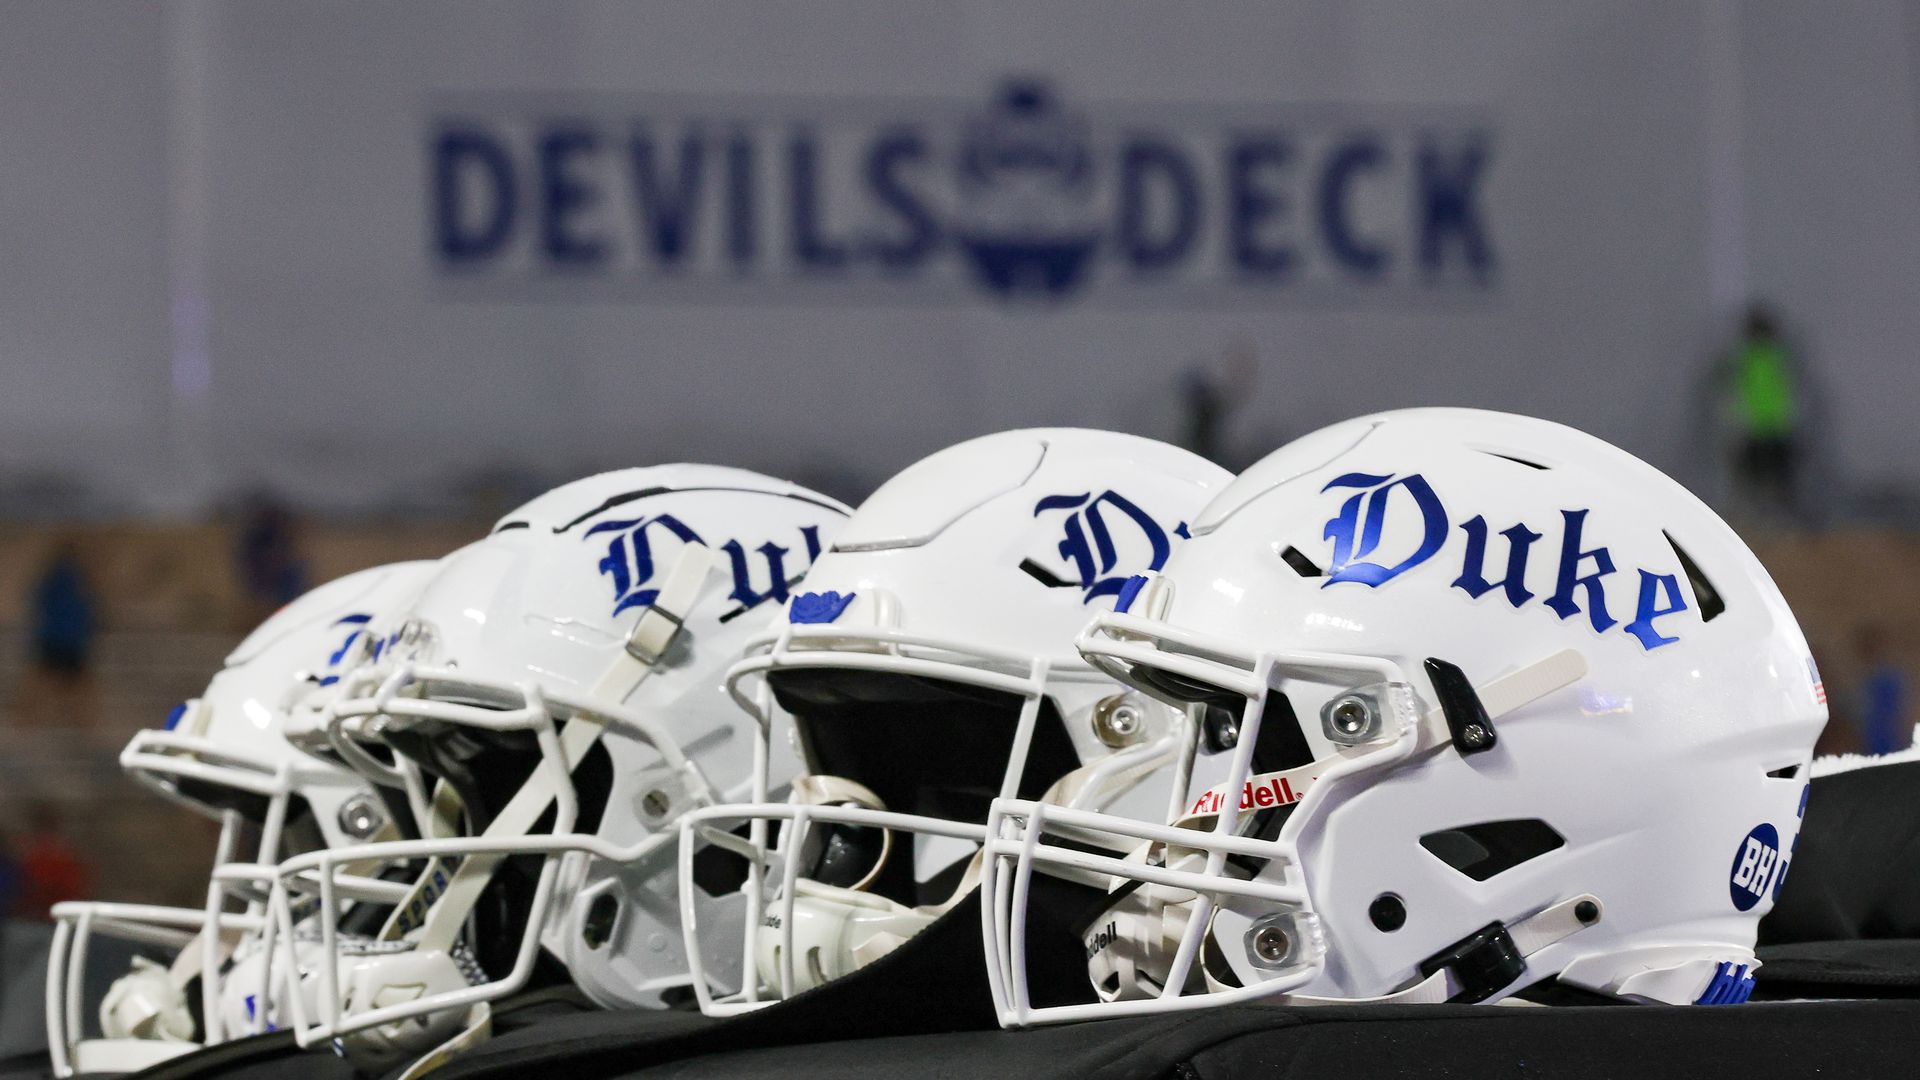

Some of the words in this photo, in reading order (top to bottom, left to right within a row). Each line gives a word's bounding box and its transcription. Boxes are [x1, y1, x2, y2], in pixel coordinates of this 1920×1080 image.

[430, 121, 943, 270] DEVILS
[1118, 130, 1495, 276] DECK
[1034, 489, 1192, 605] D
[1320, 472, 1689, 652] Duke
[1191, 777, 1295, 815] Ridell
[1732, 835, 1778, 898] BH
